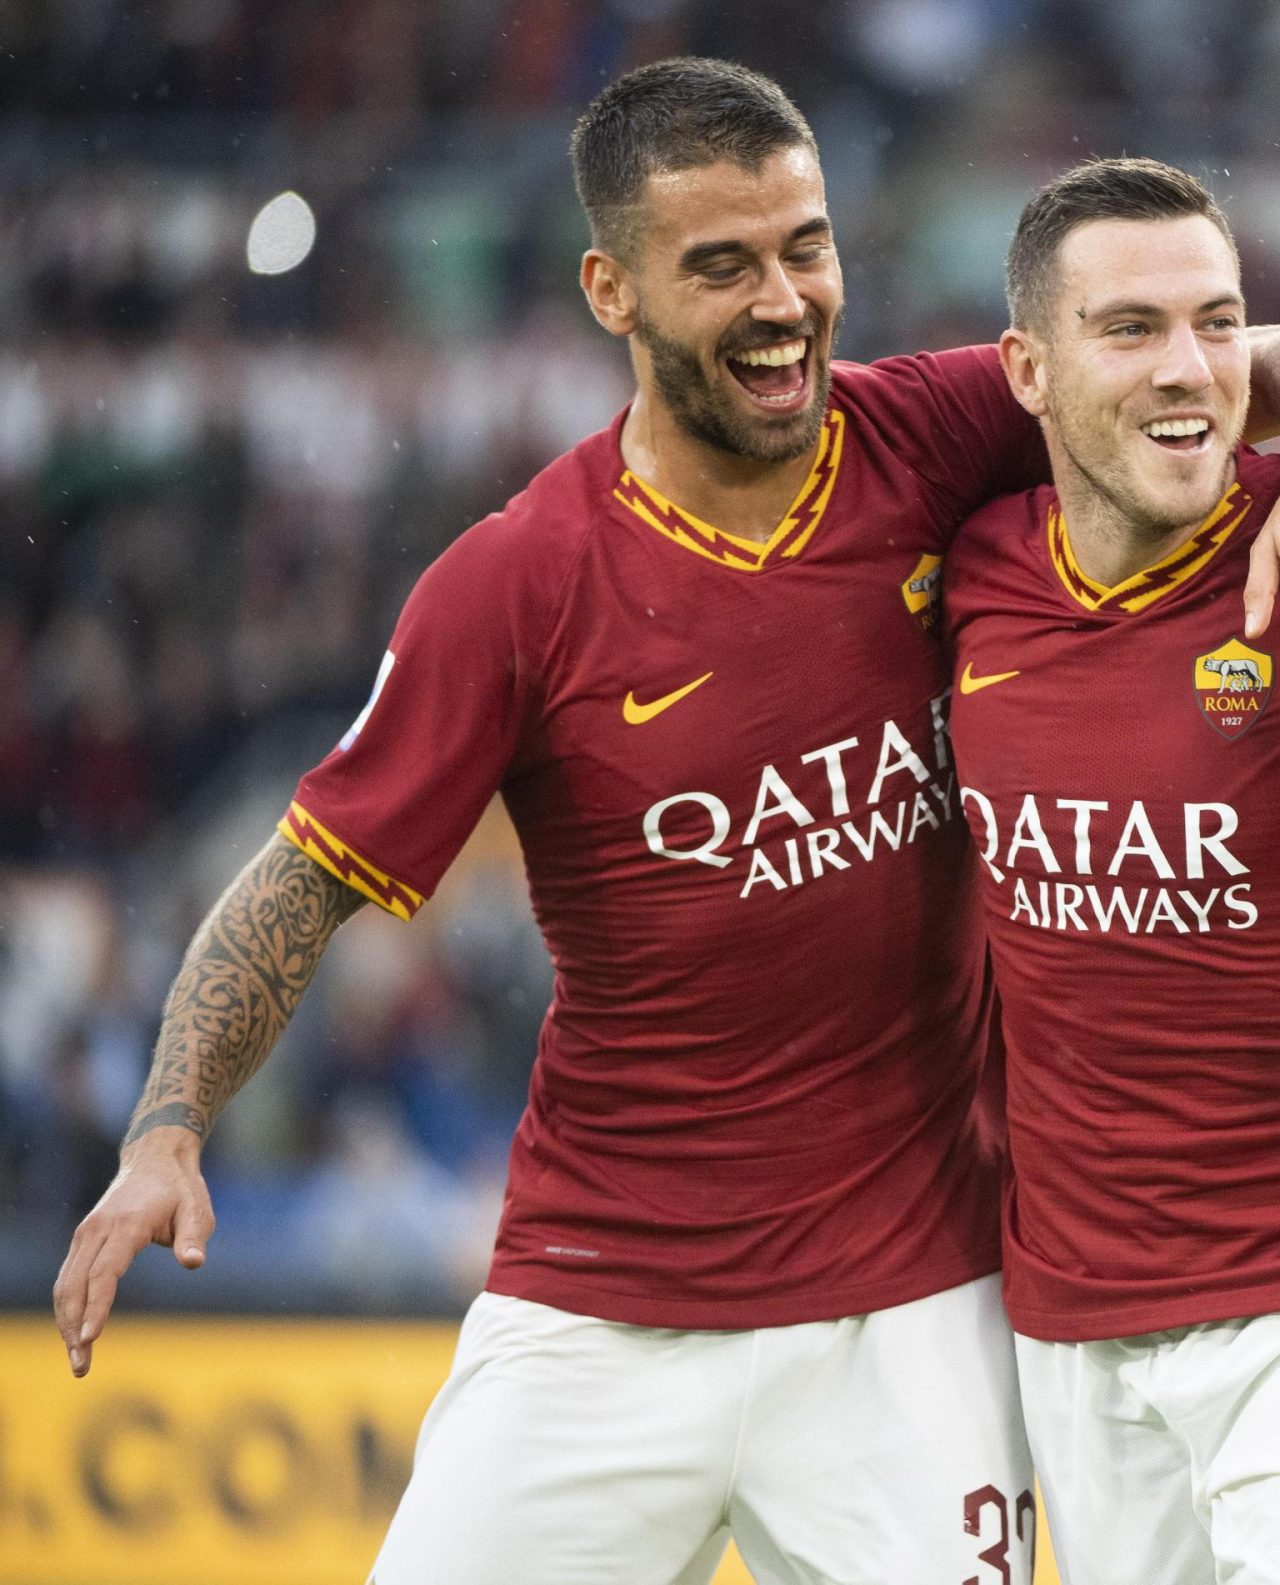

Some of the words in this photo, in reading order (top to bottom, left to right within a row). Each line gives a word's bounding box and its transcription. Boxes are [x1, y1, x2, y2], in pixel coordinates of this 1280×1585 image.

[1205, 697, 1260, 712] ROMA
[1221, 717, 1243, 726] 1927
[739, 772, 955, 899] AIRWAY
[959, 786, 1251, 884] QATAR
[1009, 877, 1259, 935] AIRWAYS
